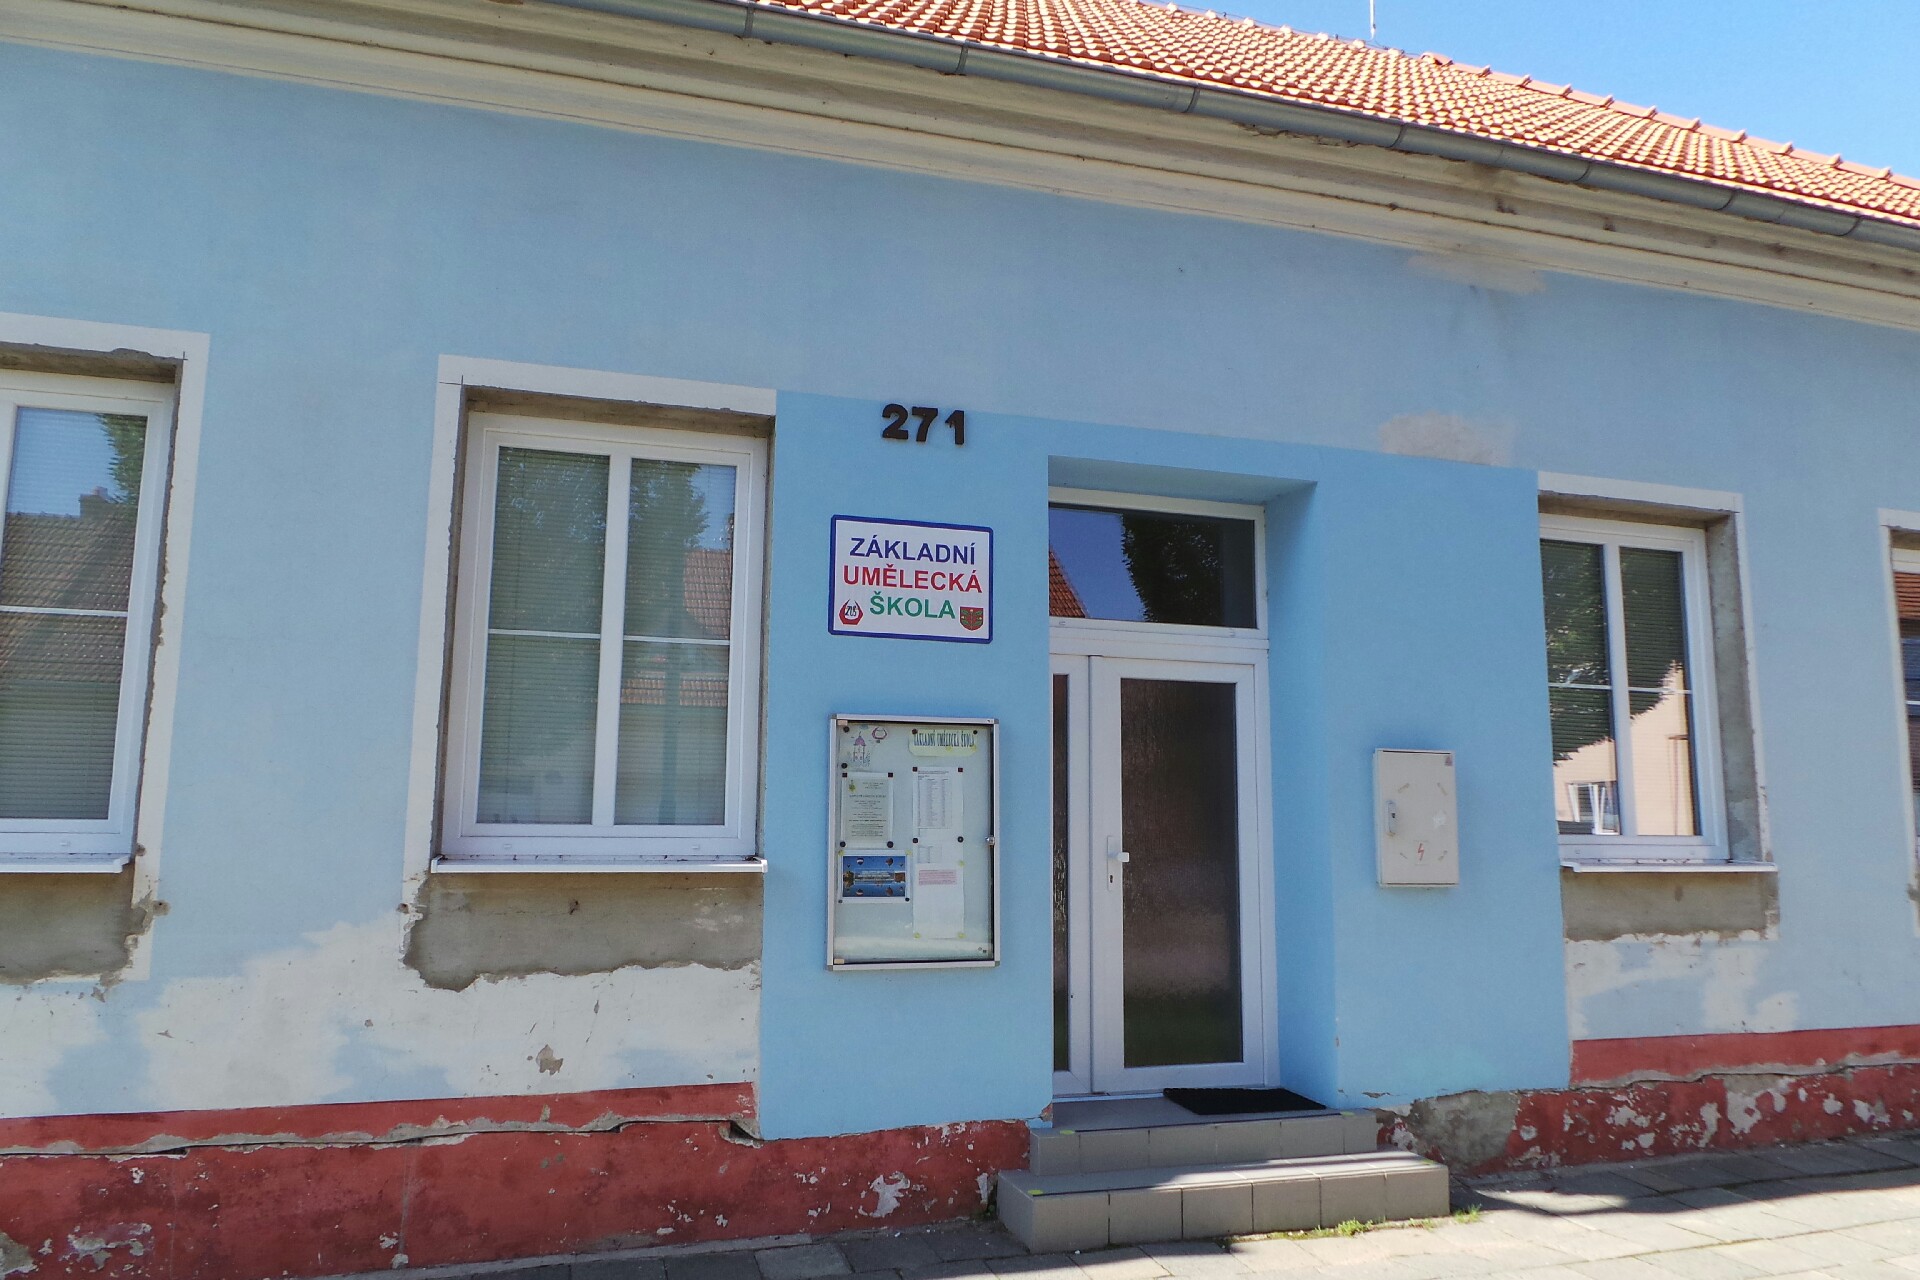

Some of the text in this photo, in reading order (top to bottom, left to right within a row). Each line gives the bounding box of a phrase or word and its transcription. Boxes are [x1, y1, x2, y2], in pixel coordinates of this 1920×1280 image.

[882, 403, 965, 445] 271
[849, 534, 976, 565] ZÁKLADNÍ
[843, 563, 983, 593] UMĚLECKÁ
[869, 591, 956, 619] ŠKOLA
